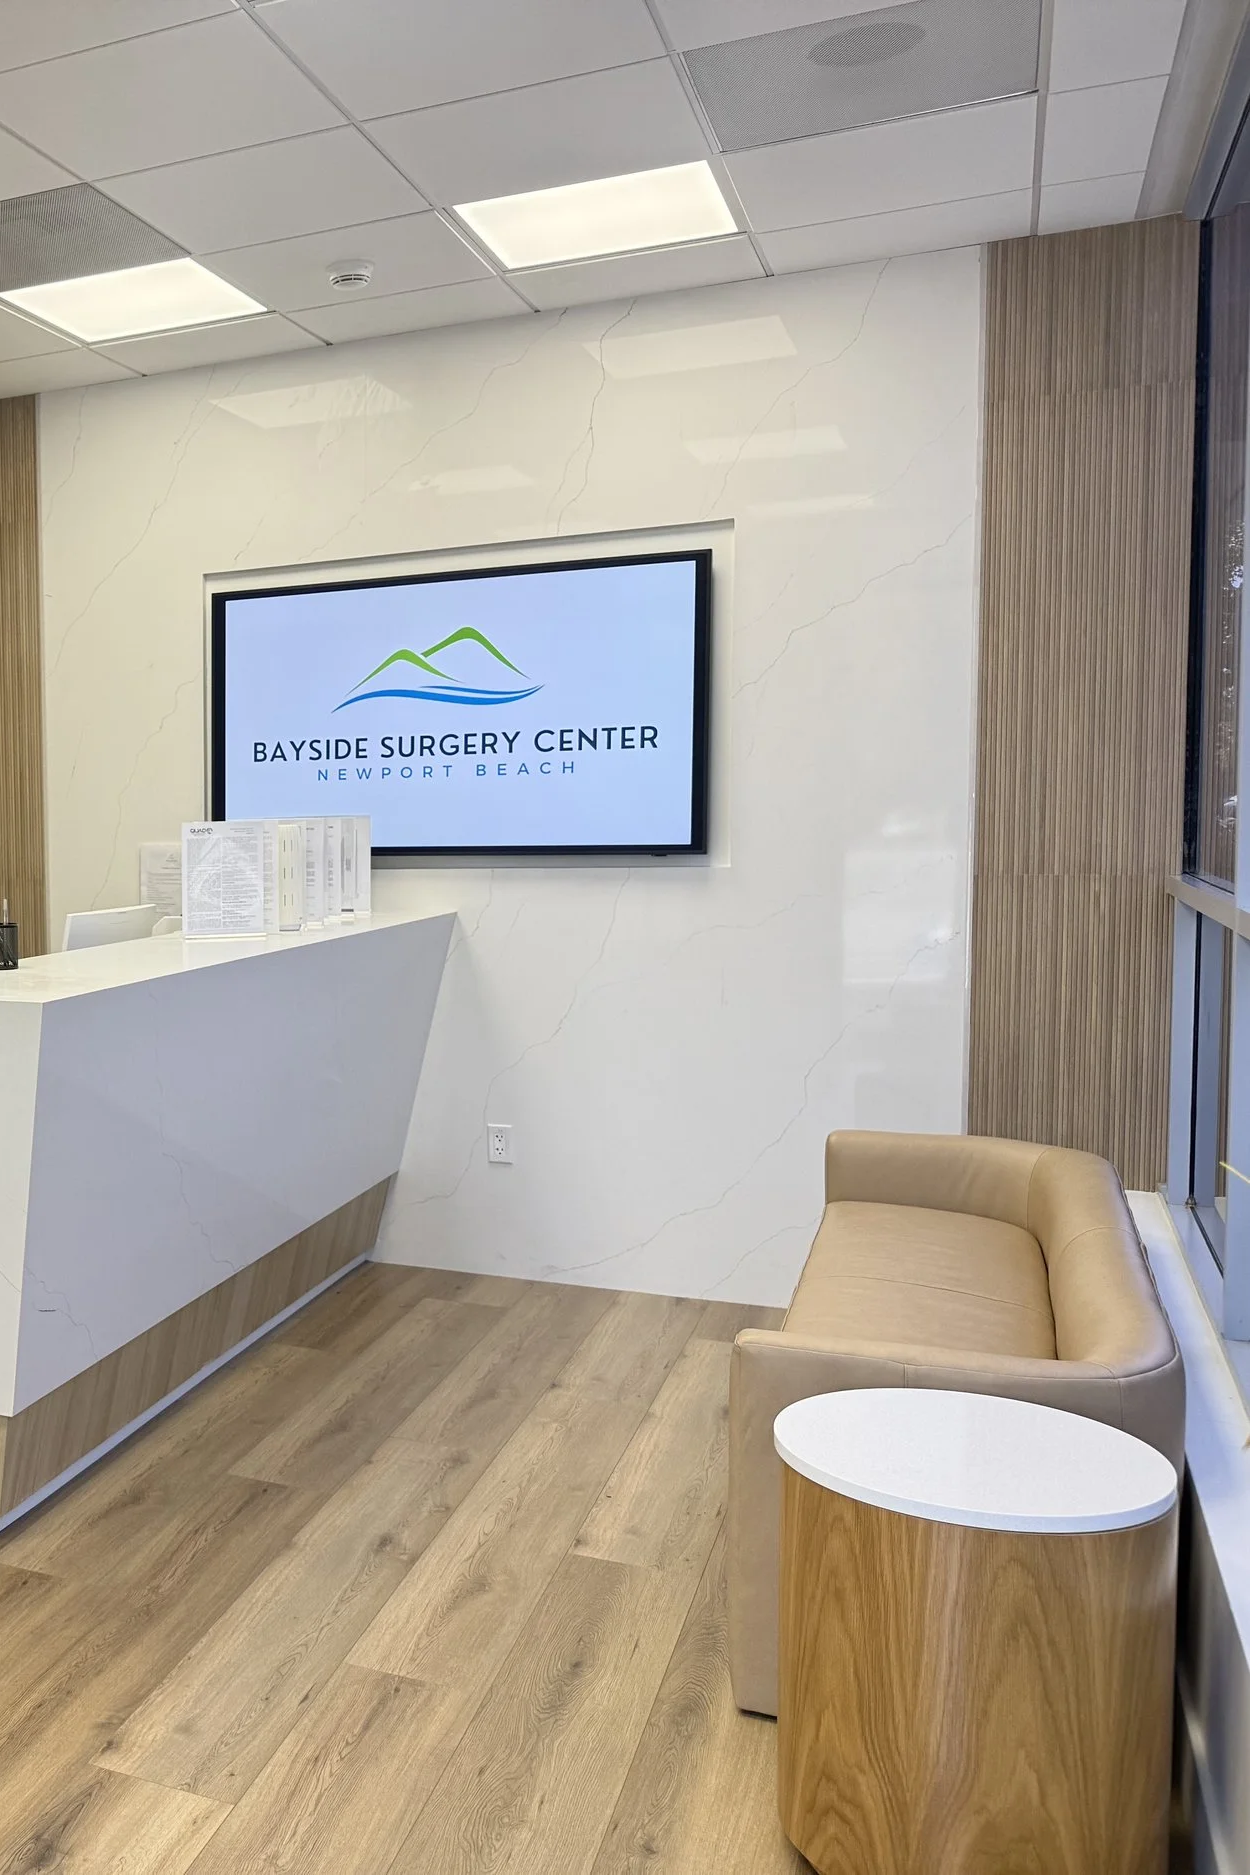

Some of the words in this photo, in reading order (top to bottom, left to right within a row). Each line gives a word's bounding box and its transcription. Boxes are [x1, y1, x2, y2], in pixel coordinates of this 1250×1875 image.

[253, 737, 370, 763] BAYSIDE
[380, 731, 521, 759] SURGERY
[533, 725, 660, 752] CENTER
[316, 764, 454, 782] NEWPORT
[476, 760, 576, 777] BEACH
